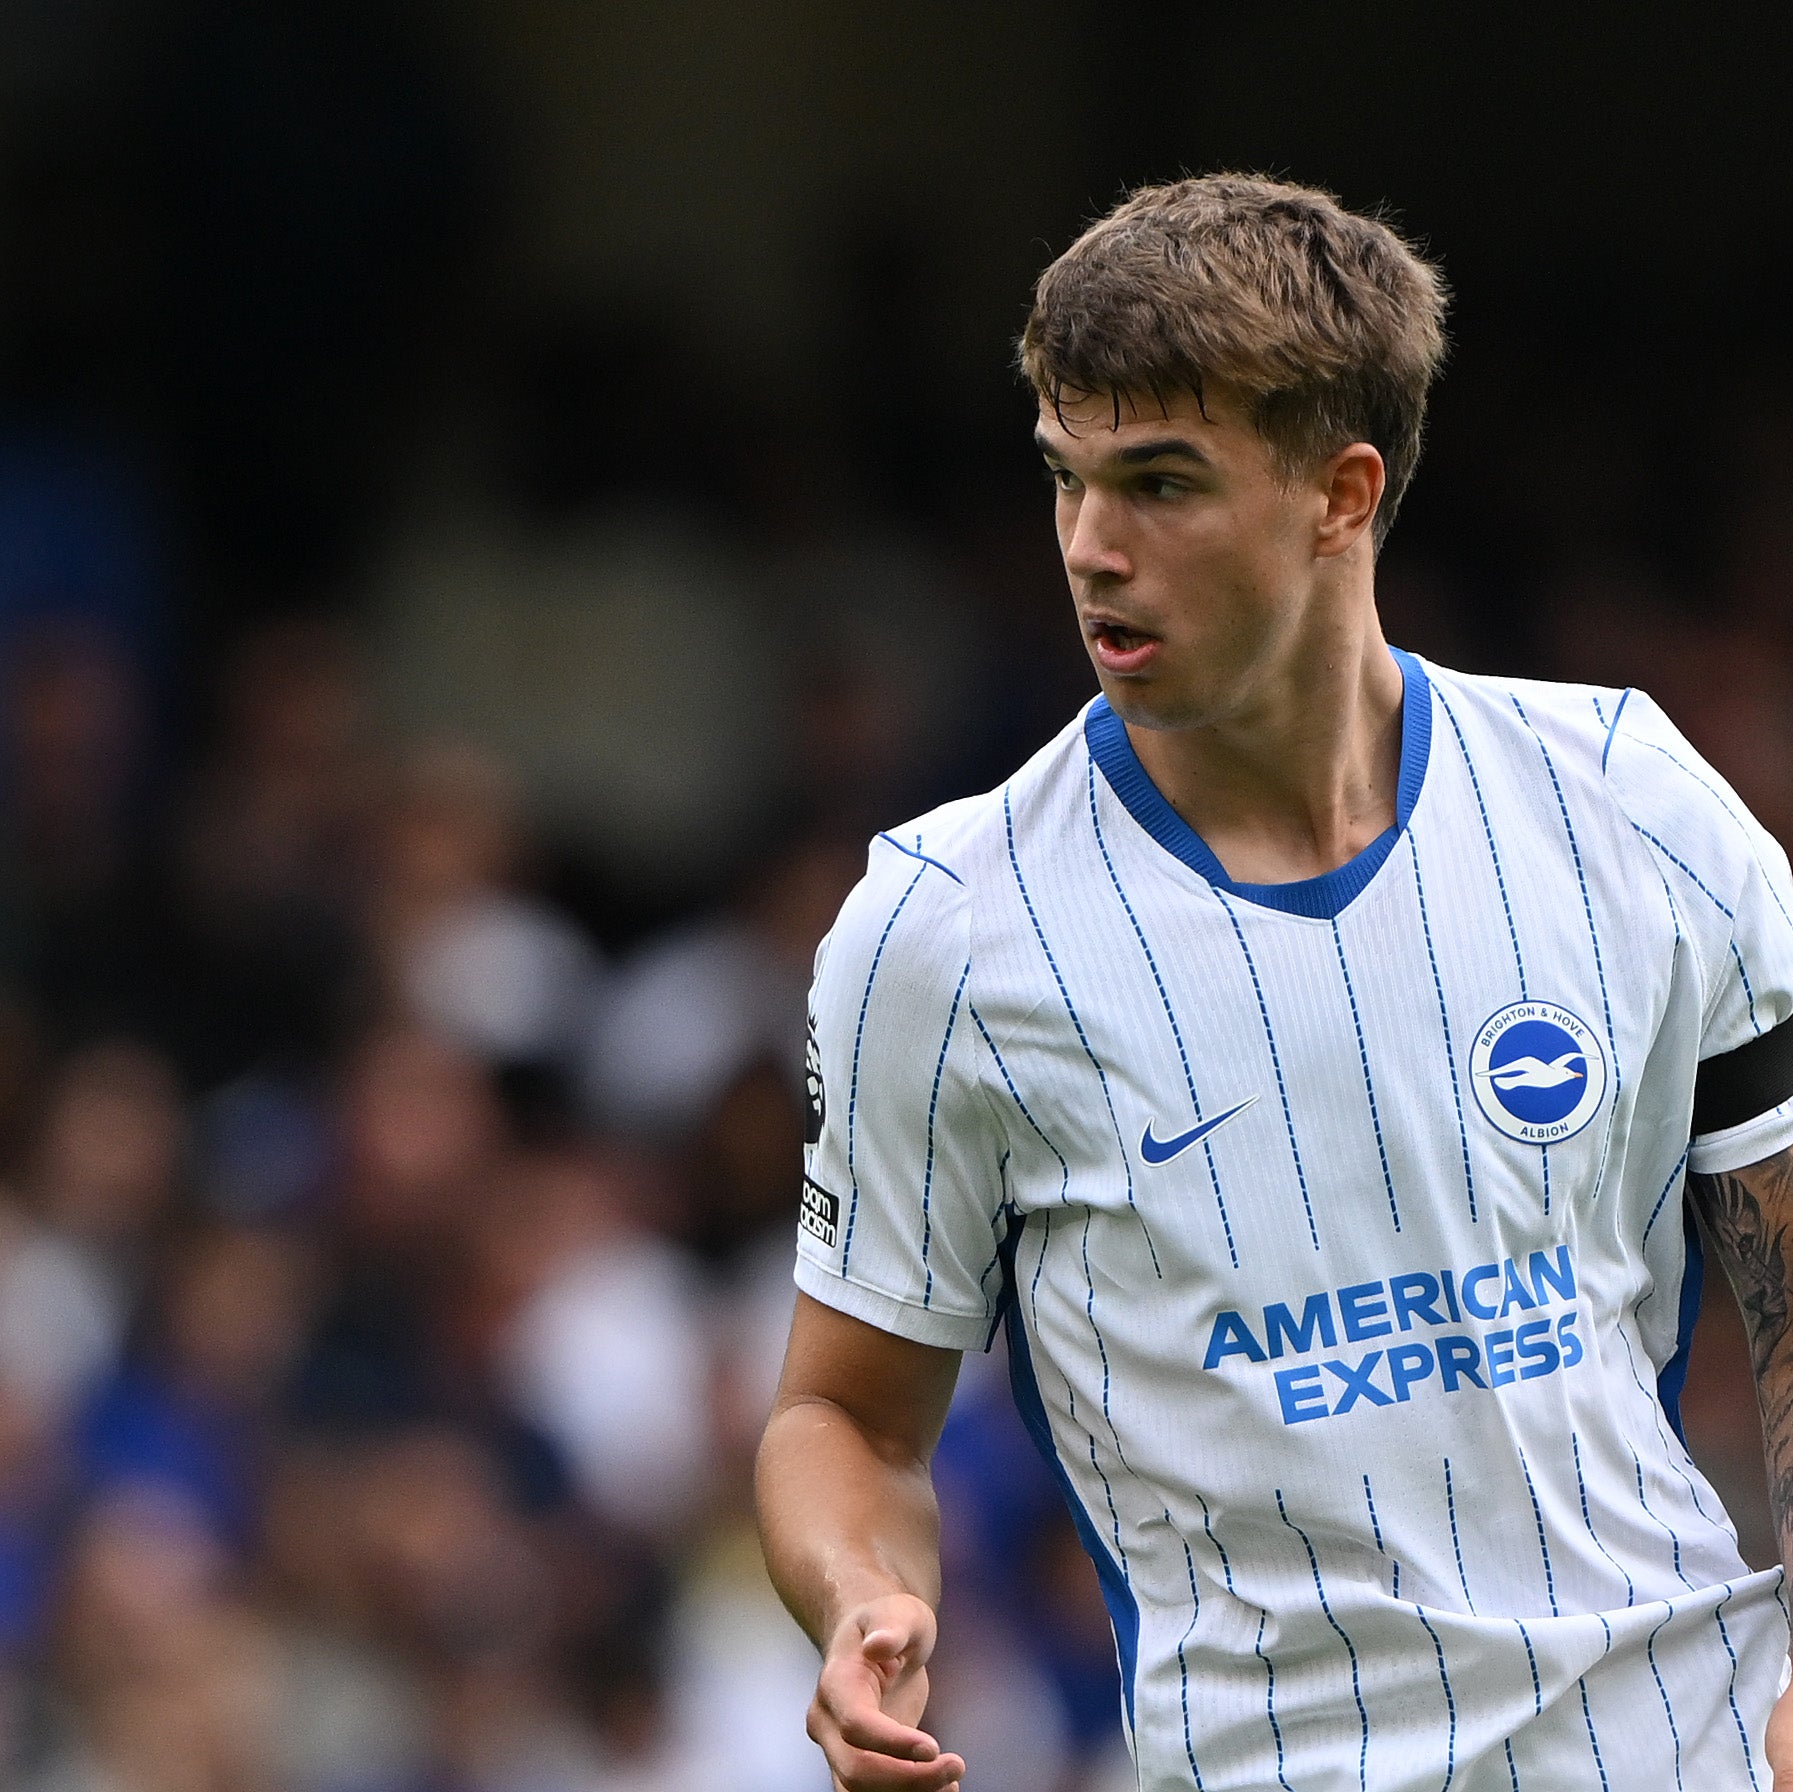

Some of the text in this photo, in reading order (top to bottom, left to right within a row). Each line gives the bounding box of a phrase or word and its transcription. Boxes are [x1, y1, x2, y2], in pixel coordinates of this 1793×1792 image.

[1481, 1007, 1585, 1047] BRIGHTON & HOVE
[1520, 1122, 1569, 1138] ALBION
[803, 1179, 831, 1220] oom
[800, 1202, 836, 1247] acism
[1202, 1244, 1578, 1370] AMERICAN
[1273, 1312, 1584, 1426] EXPRESS
